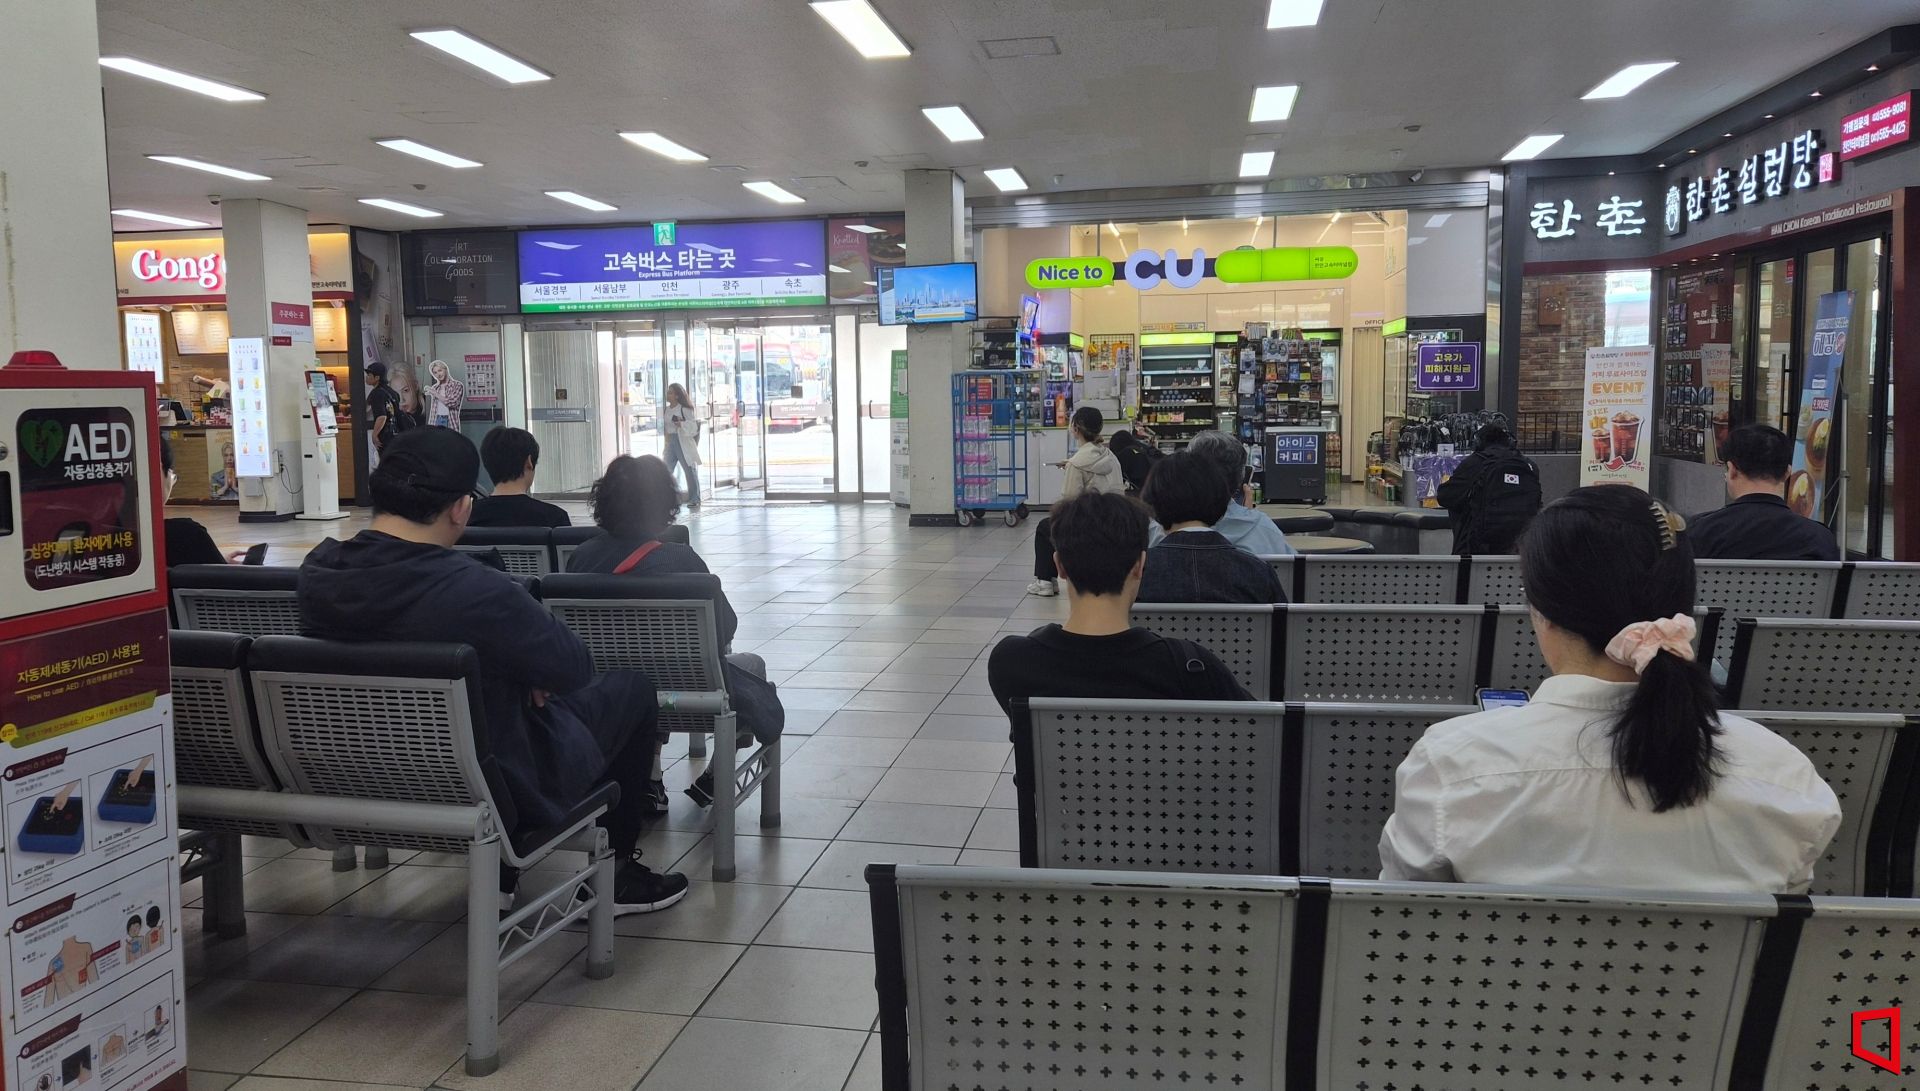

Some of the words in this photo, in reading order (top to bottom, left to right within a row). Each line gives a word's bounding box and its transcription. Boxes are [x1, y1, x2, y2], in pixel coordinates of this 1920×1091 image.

[1685, 129, 1818, 222] 한촌설렁탕
[1783, 218, 1800, 232] CHON
[1800, 214, 1821, 229] Korean
[1822, 203, 1855, 223] Traditional
[1855, 193, 1893, 214] Restaurant
[603, 250, 673, 272] 고속버스
[678, 249, 713, 270] 타는
[719, 248, 736, 269] 곳
[131, 249, 218, 289] Gong
[445, 265, 474, 282] GOODS
[638, 270, 660, 279] Express
[674, 269, 700, 277] Platform
[1038, 265, 1079, 281] Nice
[1083, 265, 1103, 279] to
[1124, 247, 1205, 290] CU
[593, 281, 627, 294] 서울남부
[661, 281, 678, 292] 인천
[722, 279, 740, 291] 광주
[784, 277, 802, 289] 속초
[533, 284, 567, 297] 서울경부
[1434, 353, 1463, 363] 고유가
[1424, 364, 1471, 374] 피해지원금
[1592, 381, 1645, 394] EVENT
[63, 422, 132, 462] AED
[1278, 436, 1316, 448] 아이스
[1278, 451, 1302, 463] 커피
[63, 461, 133, 481] 자동심장충격기
[73, 535, 112, 554] 환자에게
[114, 531, 134, 548] 사용
[34, 562, 72, 579] (도난방지
[73, 557, 97, 573] 시스템
[98, 553, 126, 567] 작동중)
[17, 651, 109, 684] 자동제세동기(AED)
[112, 642, 140, 660] 사용법
[65, 682, 79, 692] AED
